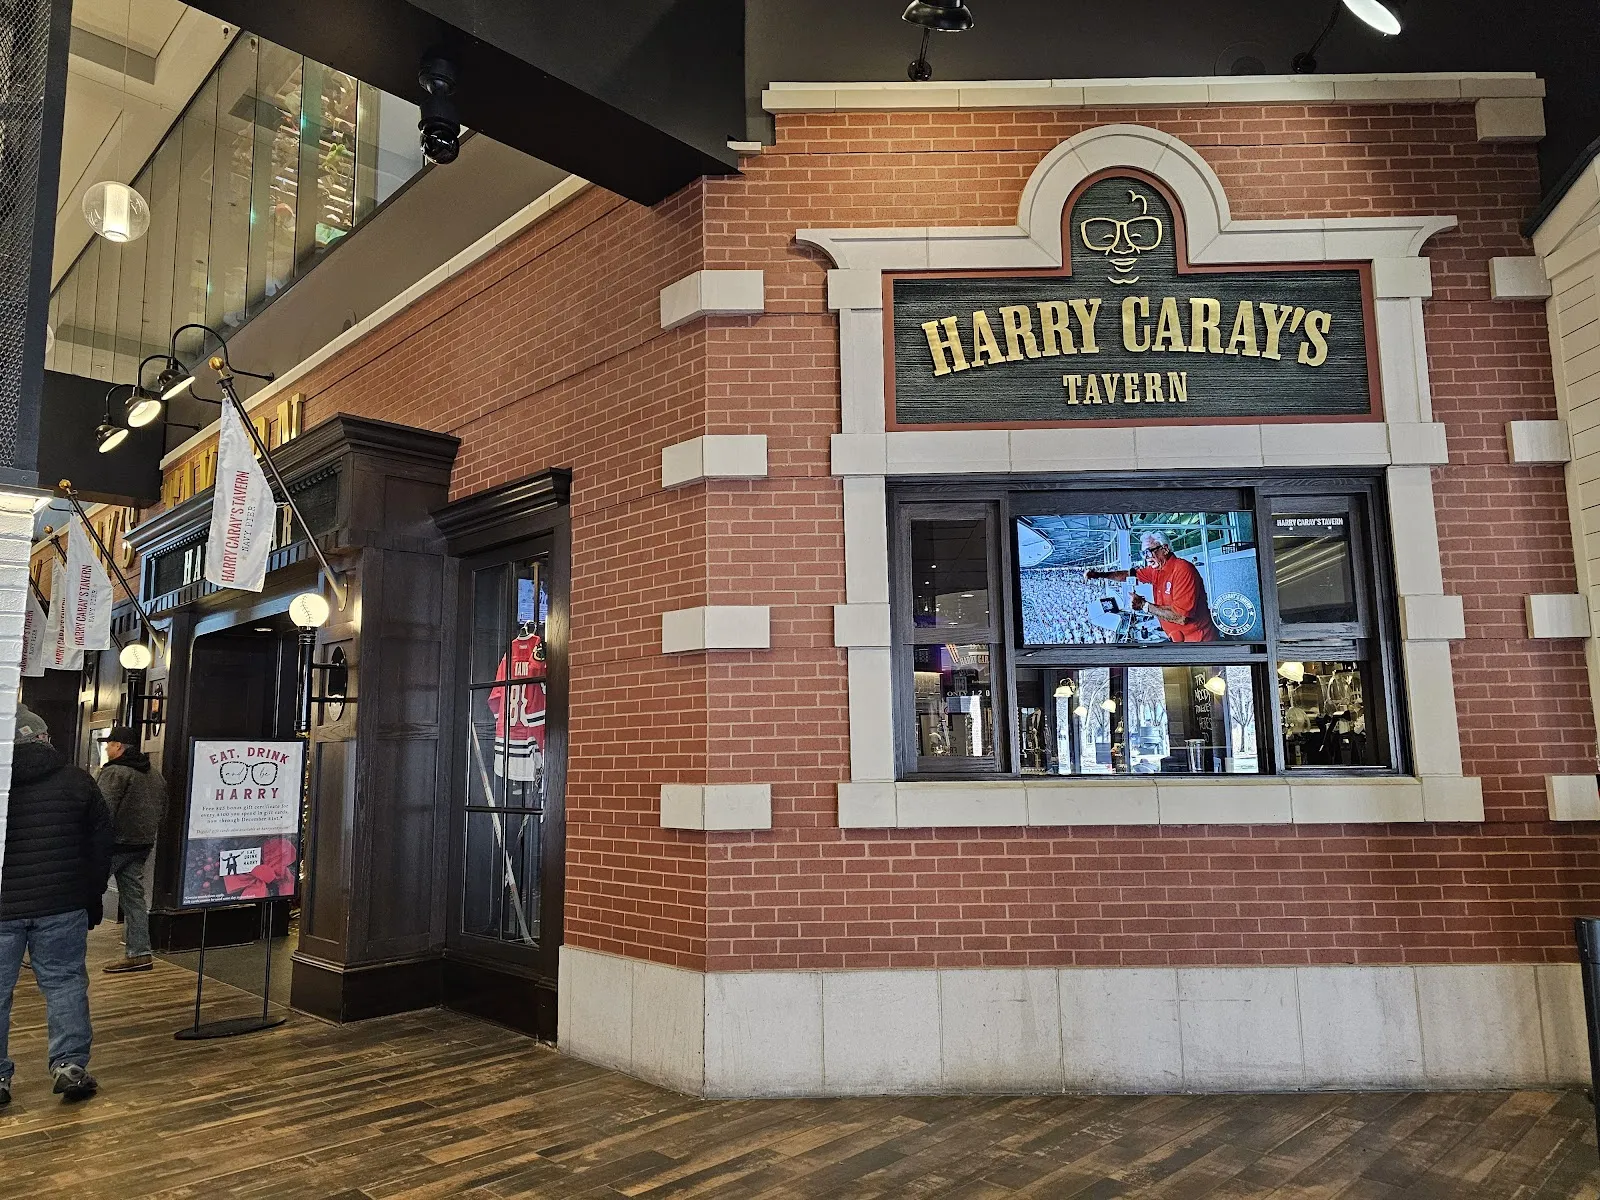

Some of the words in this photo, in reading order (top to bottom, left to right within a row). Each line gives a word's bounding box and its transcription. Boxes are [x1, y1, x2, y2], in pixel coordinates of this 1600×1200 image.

[921, 297, 1102, 377] HARRY
[1122, 295, 1332, 367] CARAY'S
[1062, 371, 1188, 405] TAVERN
[231, 470, 250, 506] TAVERN
[225, 507, 244, 550] CARAY'S
[245, 506, 256, 528] PIER
[1276, 519, 1297, 527] HARRY
[1297, 517, 1322, 527] CARAY'S
[1322, 517, 1344, 526] TAVERN
[241, 530, 252, 552] NAVY
[80, 564, 92, 591] TAVERN
[221, 549, 238, 583] HARRY
[76, 591, 89, 622] CARAY'S
[75, 622, 86, 646] HARRY
[247, 746, 290, 764] DRINK
[215, 787, 279, 801] HARRY
